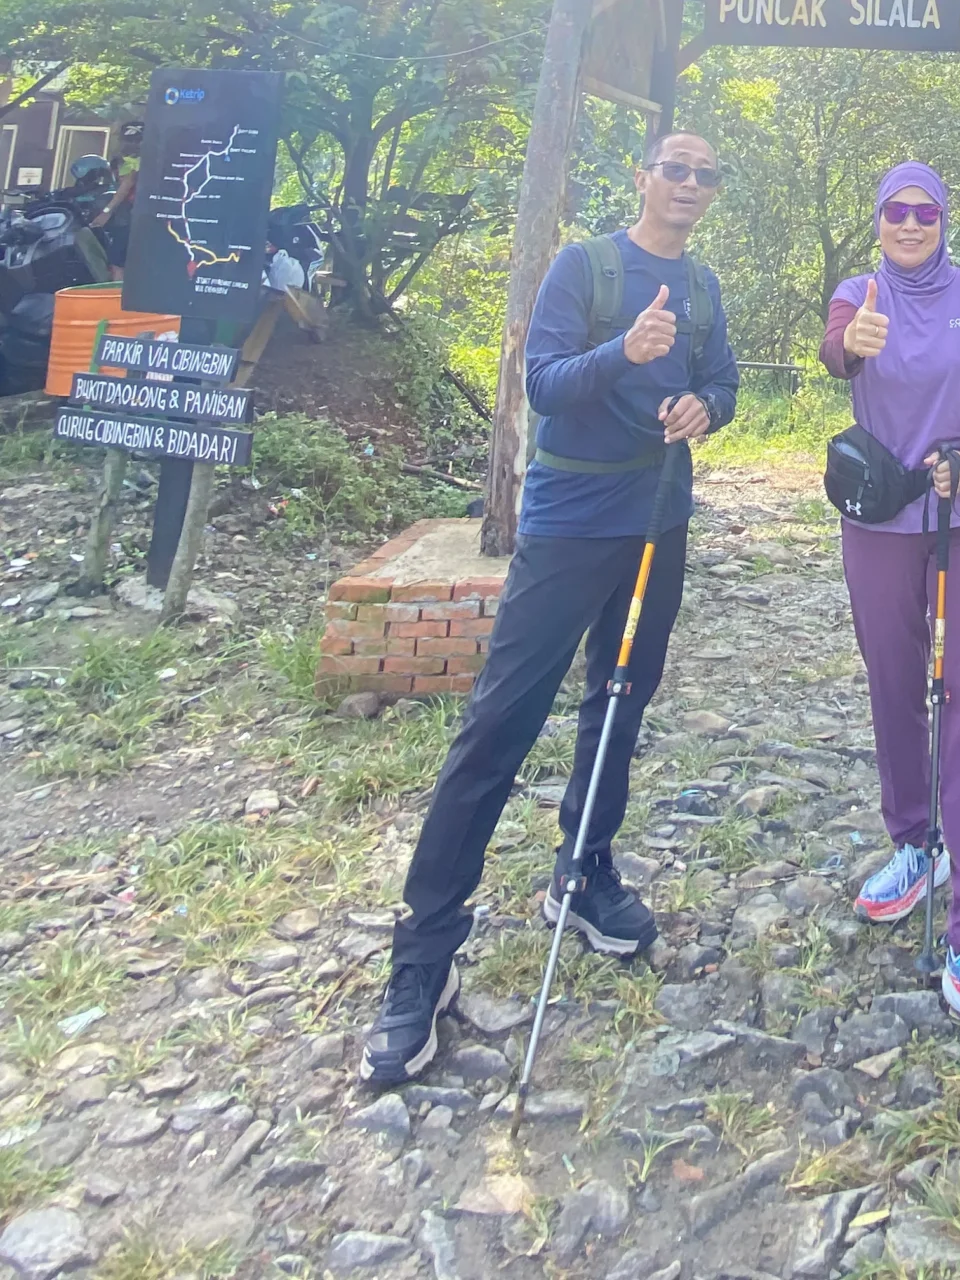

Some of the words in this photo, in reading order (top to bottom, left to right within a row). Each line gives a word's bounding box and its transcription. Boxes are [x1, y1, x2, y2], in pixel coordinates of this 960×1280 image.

[171, 348, 233, 377] CIBINGBIN
[75, 378, 107, 400] BUKIT
[106, 382, 166, 411] DAOLONG
[168, 389, 179, 409] &
[57, 414, 95, 441] CURUG
[95, 420, 154, 449] CIBINGBIN
[154, 426, 165, 448] &
[166, 428, 238, 463] BIDADARI
